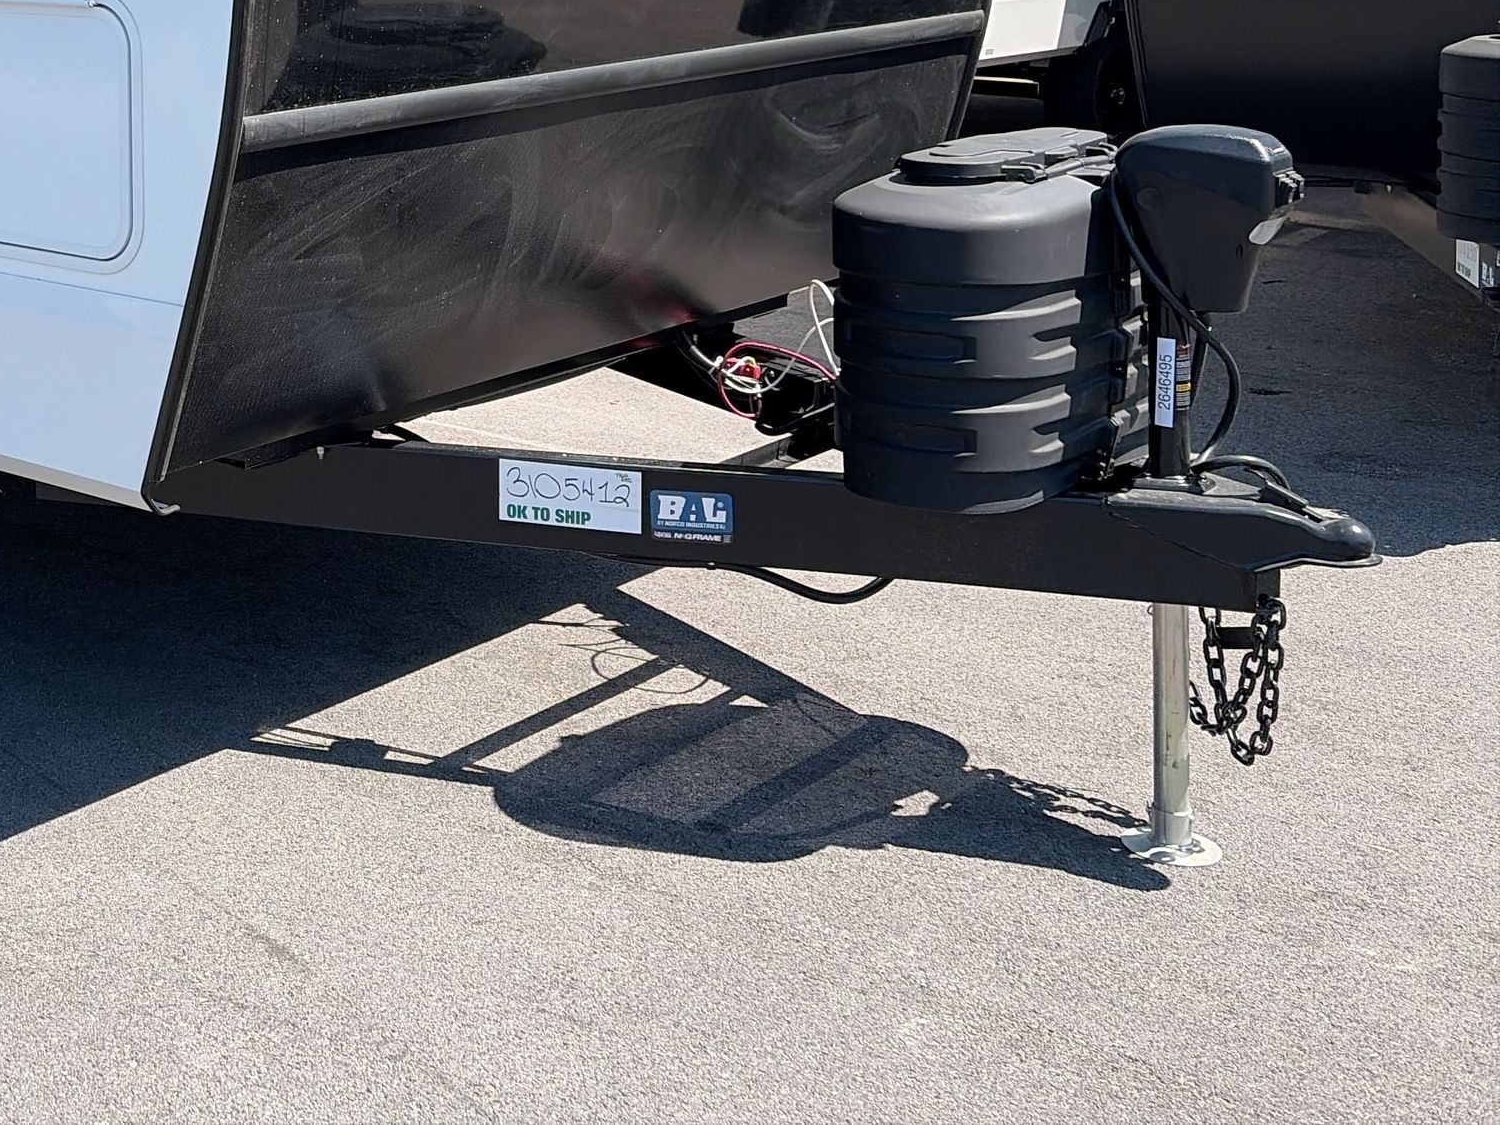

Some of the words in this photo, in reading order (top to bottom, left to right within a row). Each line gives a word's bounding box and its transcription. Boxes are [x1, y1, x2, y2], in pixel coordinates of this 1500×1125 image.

[1157, 354, 1173, 411] 2646495
[506, 503, 527, 519] OK
[532, 505, 550, 522] TO
[555, 508, 591, 525] SHIP
[657, 494, 727, 523] BAL
